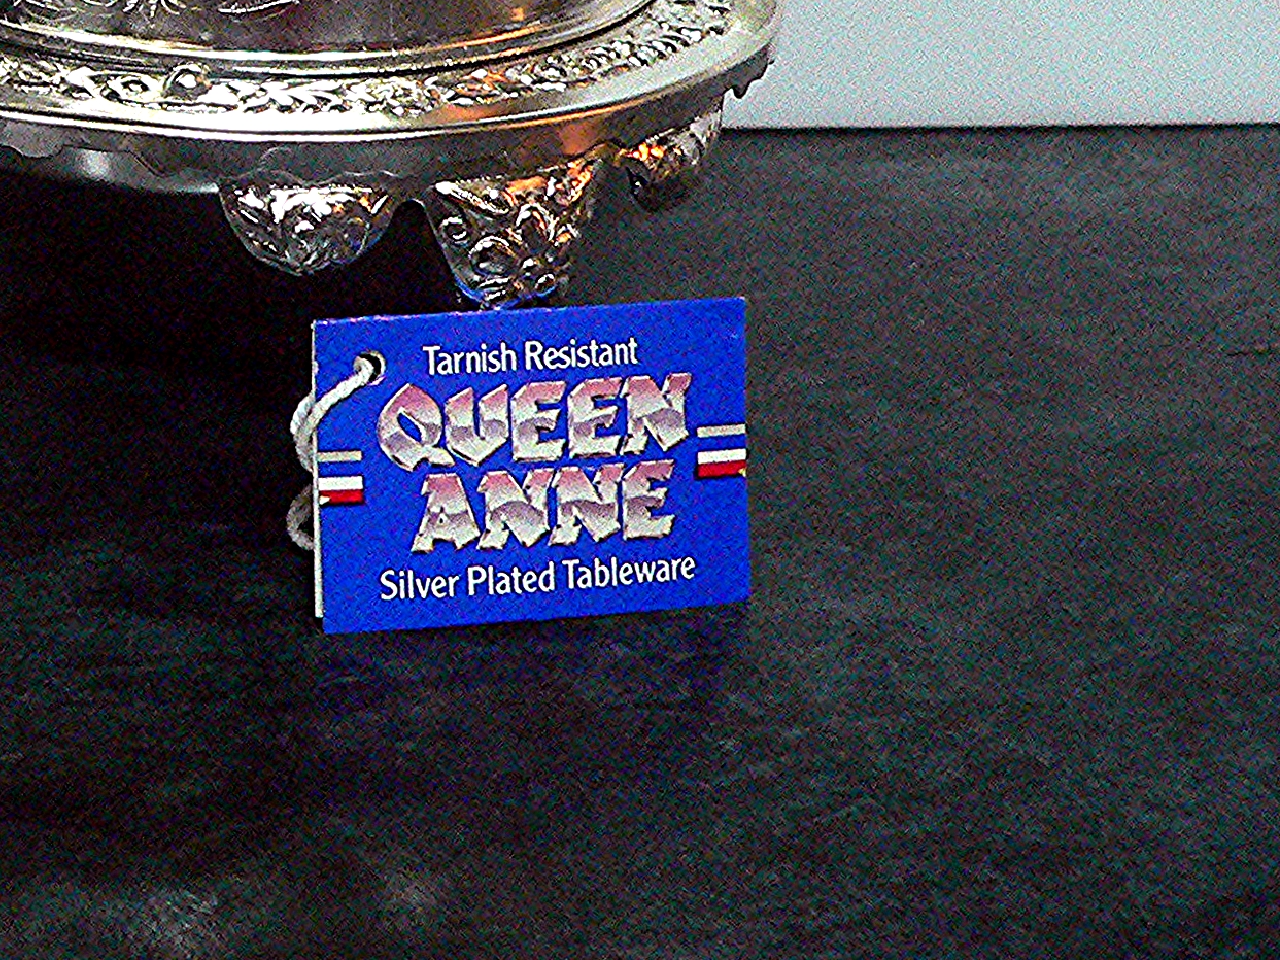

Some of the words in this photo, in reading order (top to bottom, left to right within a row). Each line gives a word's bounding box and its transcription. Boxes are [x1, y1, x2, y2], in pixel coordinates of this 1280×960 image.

[422, 342, 518, 376] Tarnish
[525, 338, 639, 371] Resistant
[376, 372, 693, 471] QUEEN
[411, 458, 675, 552] ANNE
[380, 569, 460, 601] Silver
[467, 563, 555, 597] Plated
[562, 555, 696, 590] Tableware
